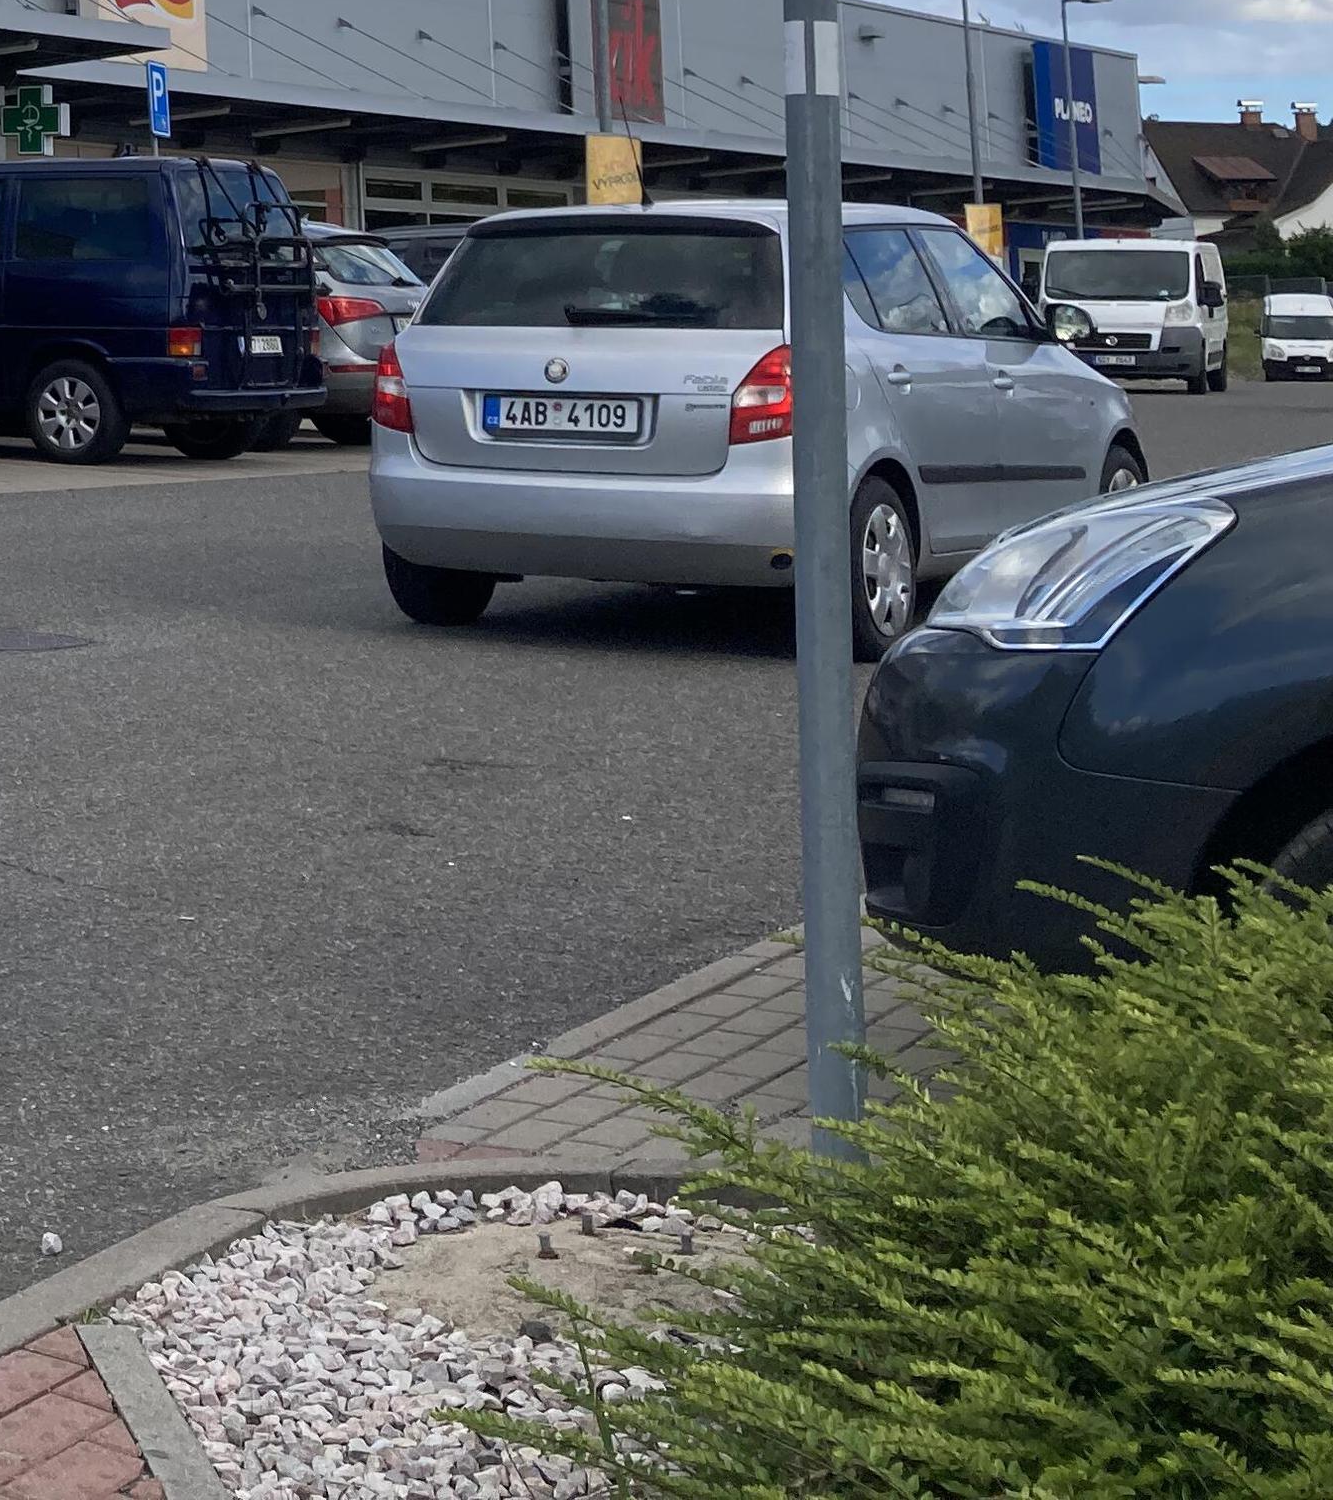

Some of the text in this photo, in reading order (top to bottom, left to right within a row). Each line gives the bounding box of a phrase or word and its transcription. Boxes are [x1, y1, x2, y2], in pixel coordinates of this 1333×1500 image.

[152, 70, 164, 112] P
[505, 400, 548, 427] 4AB
[567, 401, 627, 429] 4109
